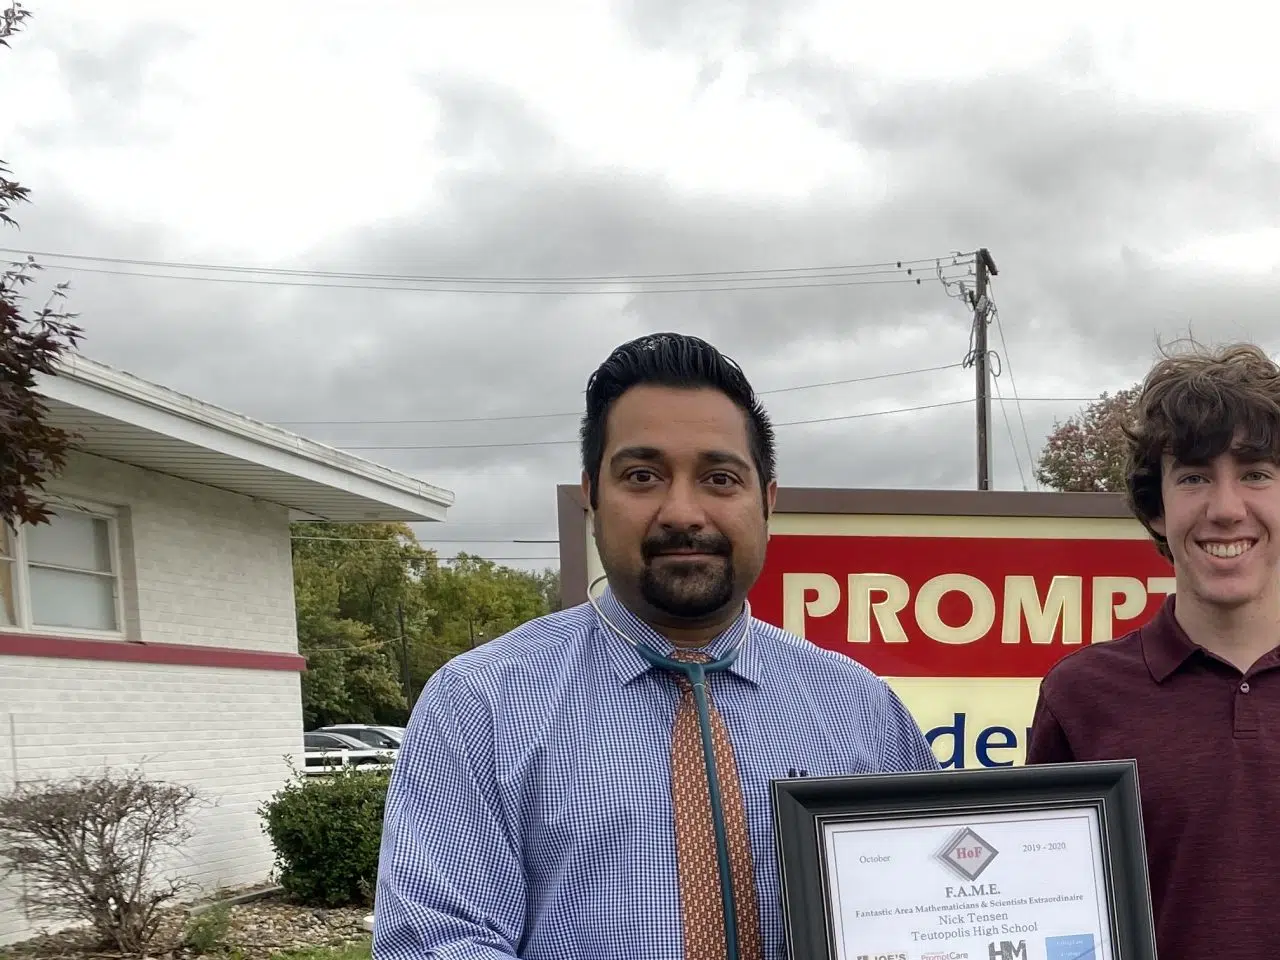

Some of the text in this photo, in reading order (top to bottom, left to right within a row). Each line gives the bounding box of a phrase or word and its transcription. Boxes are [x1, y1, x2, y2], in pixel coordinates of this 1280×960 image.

[957, 846, 983, 860] HoF
[1022, 843, 1041, 853] 2019
[1048, 841, 1067, 851] 2020
[859, 854, 891, 864] October
[945, 883, 1001, 898] F.A.M.E.
[855, 908, 892, 918] Fantastic
[894, 907, 914, 915] Area
[915, 902, 980, 913] Mathematicians
[990, 897, 1028, 907] Scientists
[1029, 894, 1084, 904] Extraordinaire
[939, 912, 1009, 925] Nick Tensen
[911, 921, 1038, 942] Teutopolis High School
